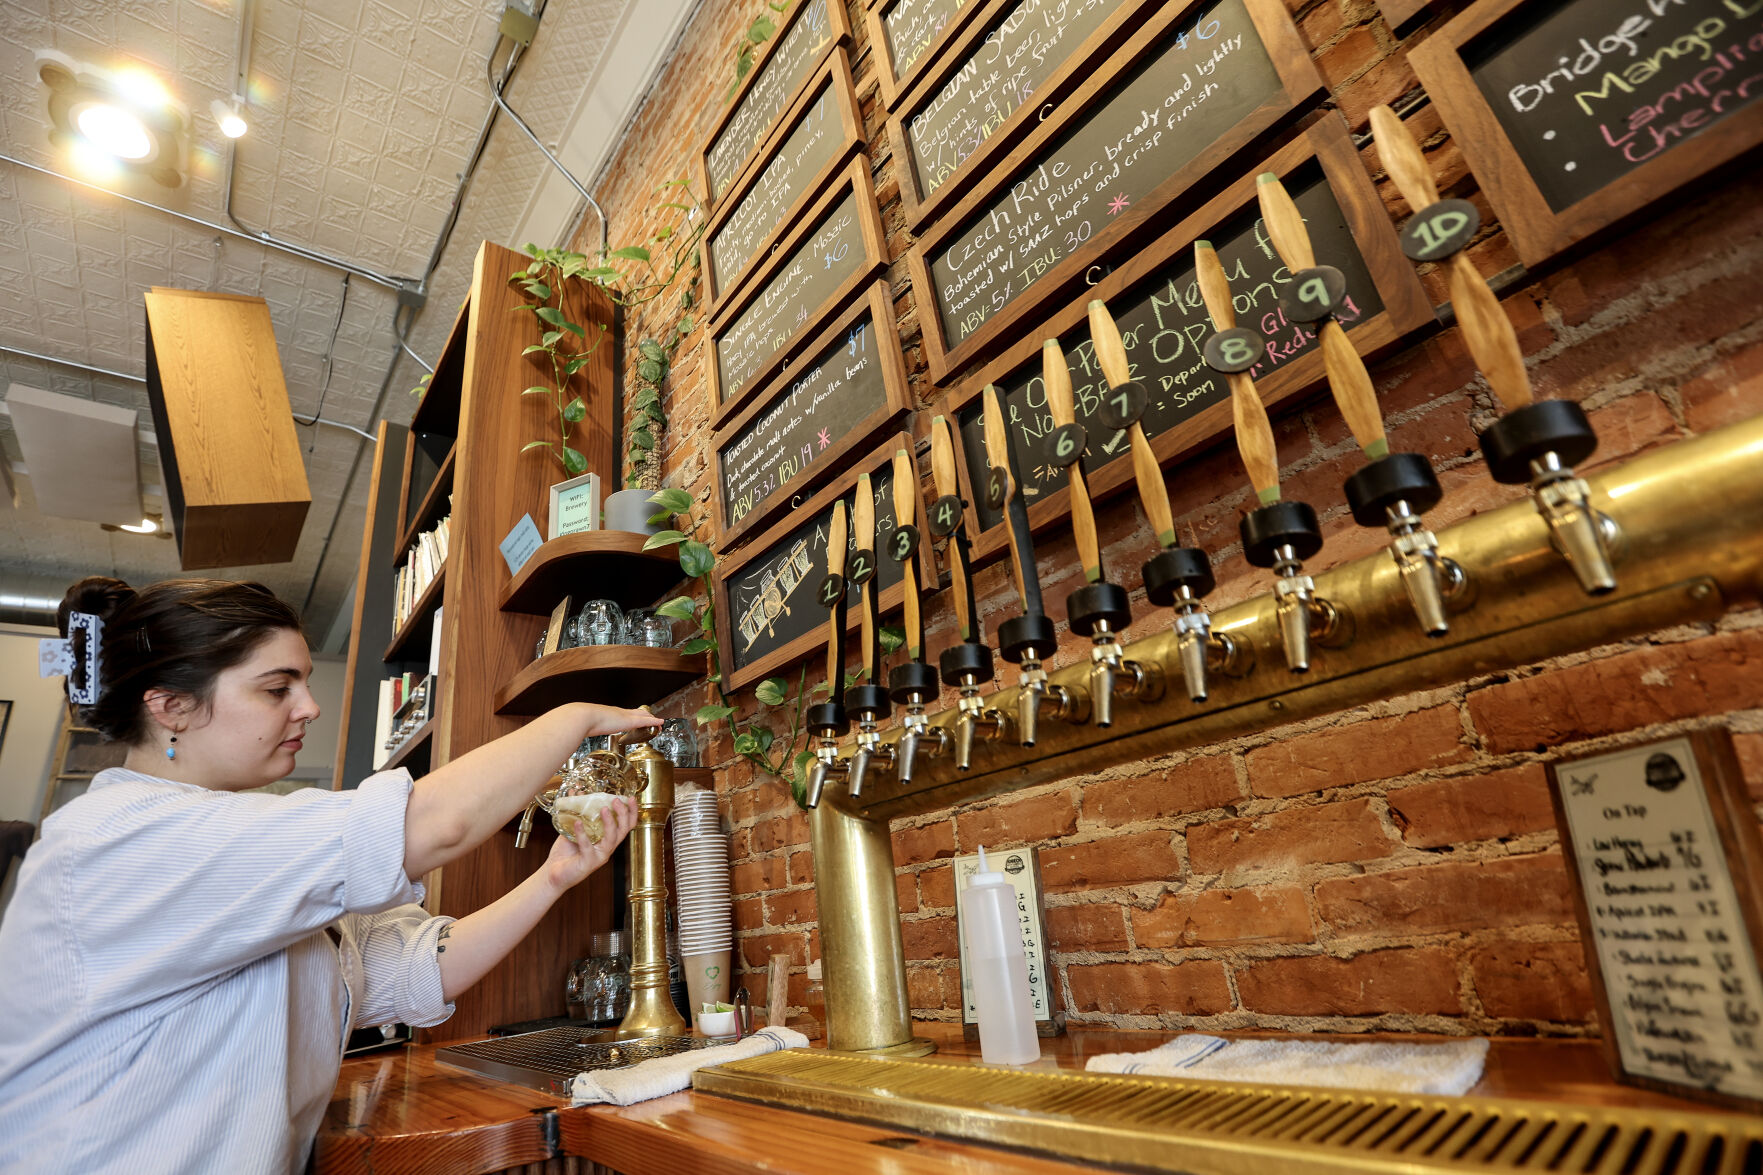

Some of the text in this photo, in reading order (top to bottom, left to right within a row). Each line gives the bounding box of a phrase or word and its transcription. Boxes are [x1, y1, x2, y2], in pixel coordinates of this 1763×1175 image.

[911, 14, 937, 45] dark
[1175, 13, 1220, 50] $6
[904, 34, 932, 72] ABV
[1508, 14, 1654, 113] Bridge
[1574, 17, 1726, 116] Mango
[912, 58, 978, 142] BELGIAN
[919, 107, 967, 158] Belgian
[968, 69, 1002, 105] table
[1006, 29, 1041, 69] beer,
[926, 144, 943, 173] w/
[949, 117, 979, 150] hints
[984, 89, 999, 115] of
[1002, 65, 1032, 96] ripe
[1623, 73, 1763, 162] Cherr
[928, 151, 958, 195] ABV
[982, 101, 1012, 140] IBU
[1017, 79, 1034, 106] 18
[944, 244, 1005, 303] Bohemian
[1104, 107, 1160, 161] bready
[1164, 73, 1192, 109] and
[1195, 33, 1243, 76] lightly
[715, 154, 786, 254] APRICOT IPA
[771, 183, 791, 210] IPA
[948, 81, 1220, 316] toasted w/ SAAZ hops and crisp finish
[947, 161, 1071, 271] Czech Ride
[1408, 208, 1469, 257] 10
[824, 238, 848, 270] $6
[991, 281, 1013, 312] 5%
[1064, 220, 1092, 253] 30
[722, 304, 763, 355] SINGLE
[764, 258, 804, 308] ENGINE
[813, 215, 852, 257] Mosaic
[1150, 258, 1251, 330] Meu
[1298, 277, 1330, 307] 9
[744, 333, 756, 349] IPA
[848, 323, 866, 358] $7
[1219, 337, 1254, 366] 8
[728, 375, 744, 398] ABV
[1110, 392, 1128, 418] 7
[724, 367, 822, 466] TOASTED COCONUT PORTER
[1056, 430, 1075, 457] 6
[732, 489, 753, 526] ABV
[779, 455, 798, 486] IBU
[801, 443, 814, 467] 19
[990, 474, 1000, 501] 5
[565, 501, 588, 512] Brewery
[937, 506, 952, 526] 4
[813, 524, 827, 550] A
[895, 530, 911, 561] 3
[853, 557, 872, 580] 2
[823, 580, 839, 603] 1
